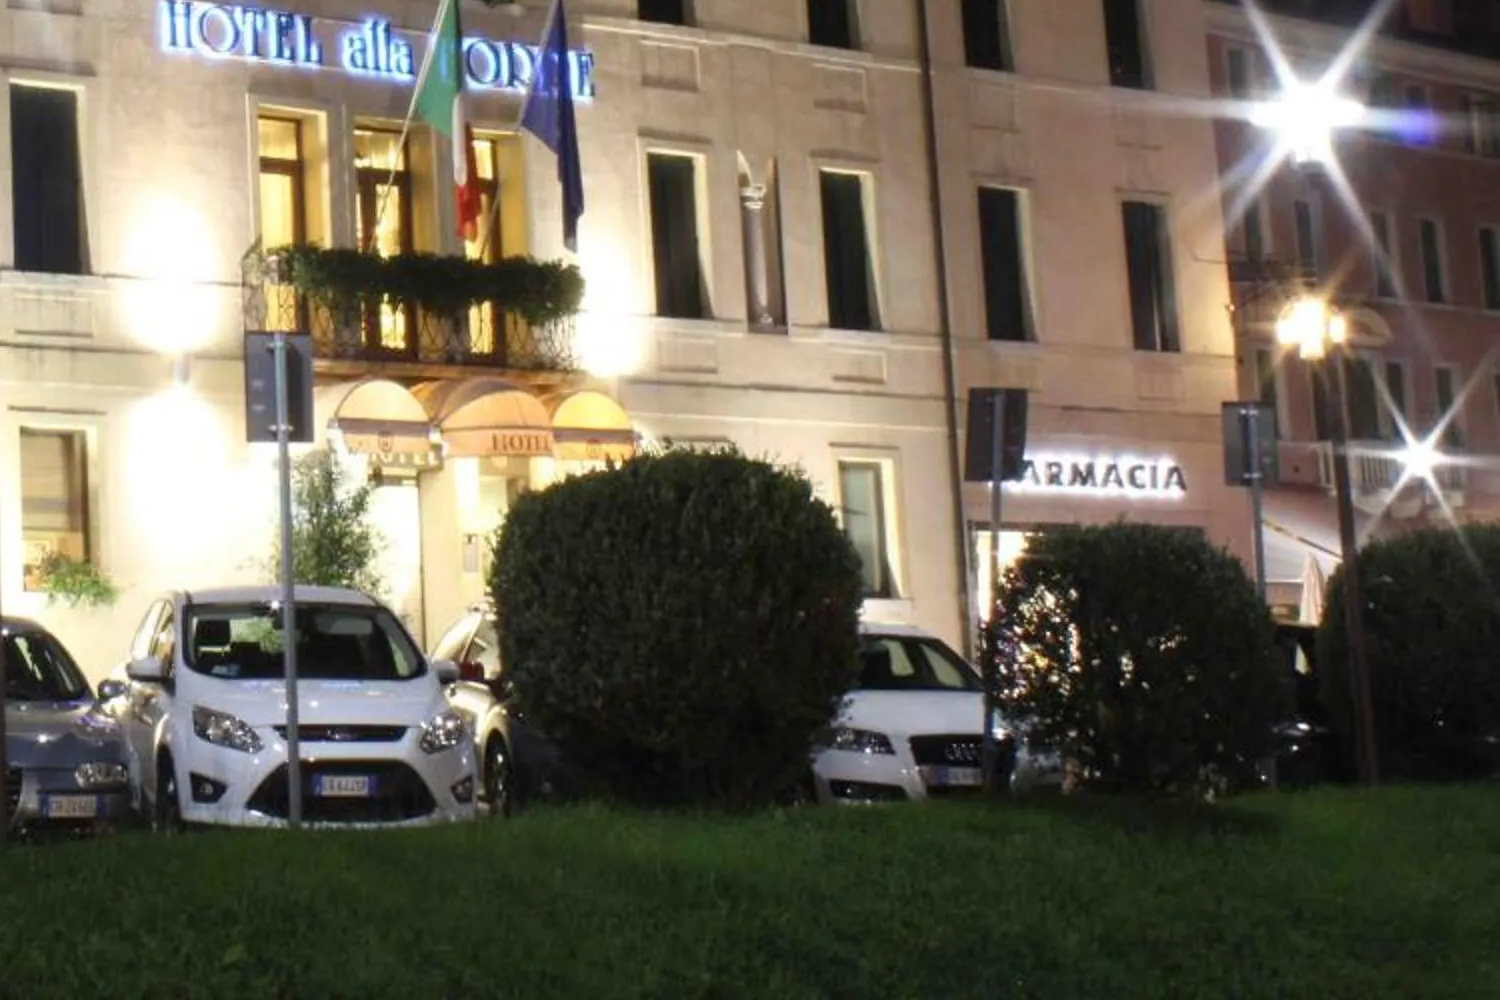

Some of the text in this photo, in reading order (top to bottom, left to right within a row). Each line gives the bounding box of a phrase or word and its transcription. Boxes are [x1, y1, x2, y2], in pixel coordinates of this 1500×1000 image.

[345, 18, 415, 77] alla
[432, 31, 597, 100] ORE
[1017, 457, 1188, 491] ARMACIA
